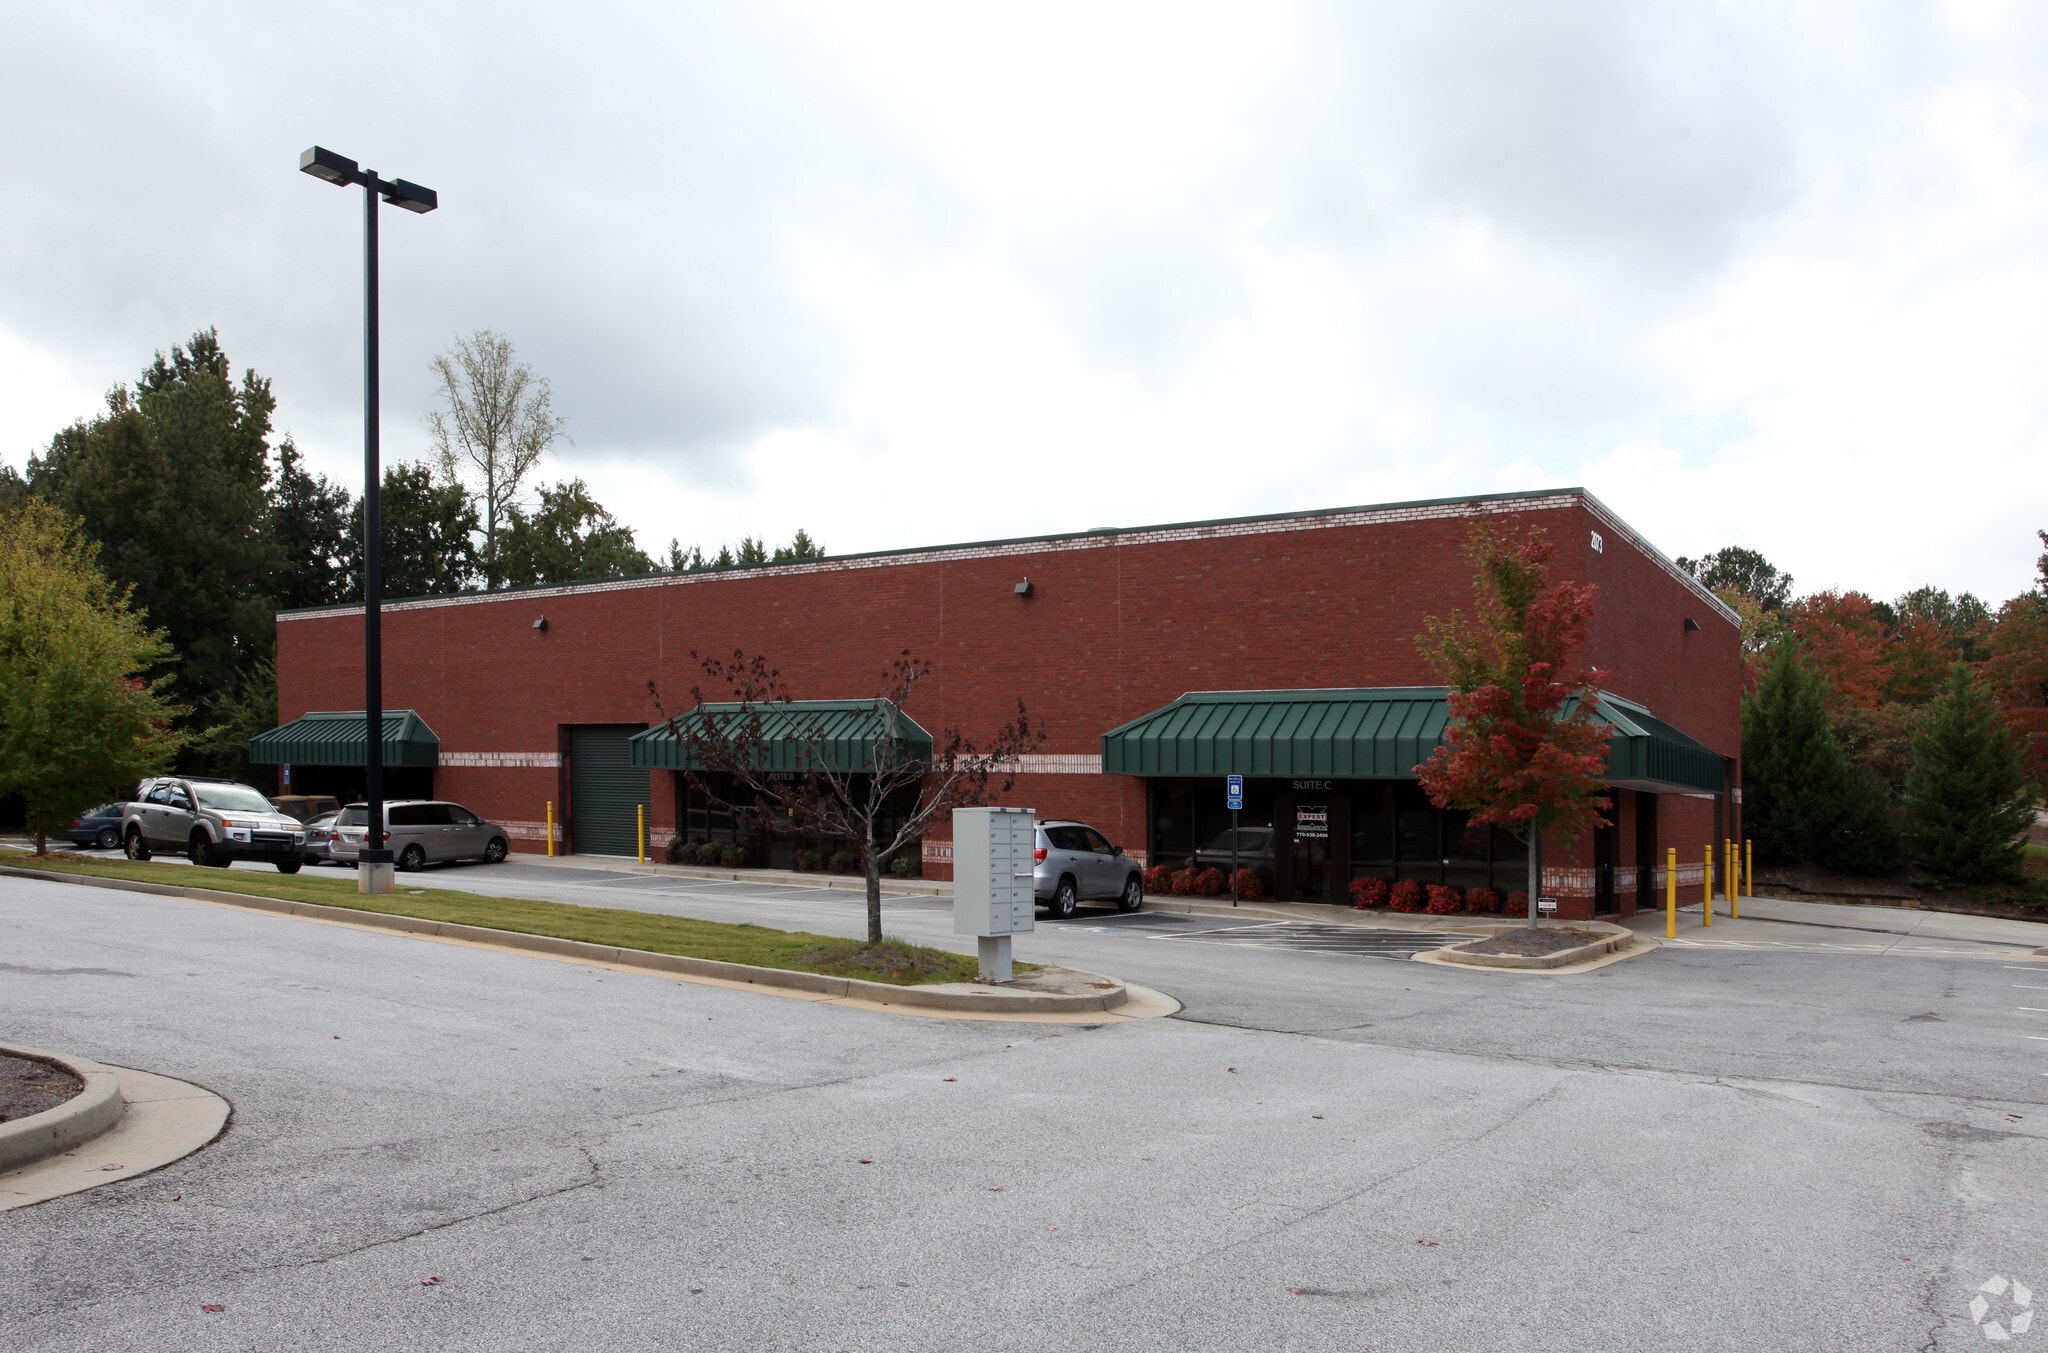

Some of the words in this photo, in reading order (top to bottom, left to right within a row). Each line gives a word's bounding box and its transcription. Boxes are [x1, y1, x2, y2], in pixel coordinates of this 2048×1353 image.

[1591, 530, 1603, 554] 2073
[1293, 780, 1322, 790] SUITE
[1324, 780, 1332, 790] C
